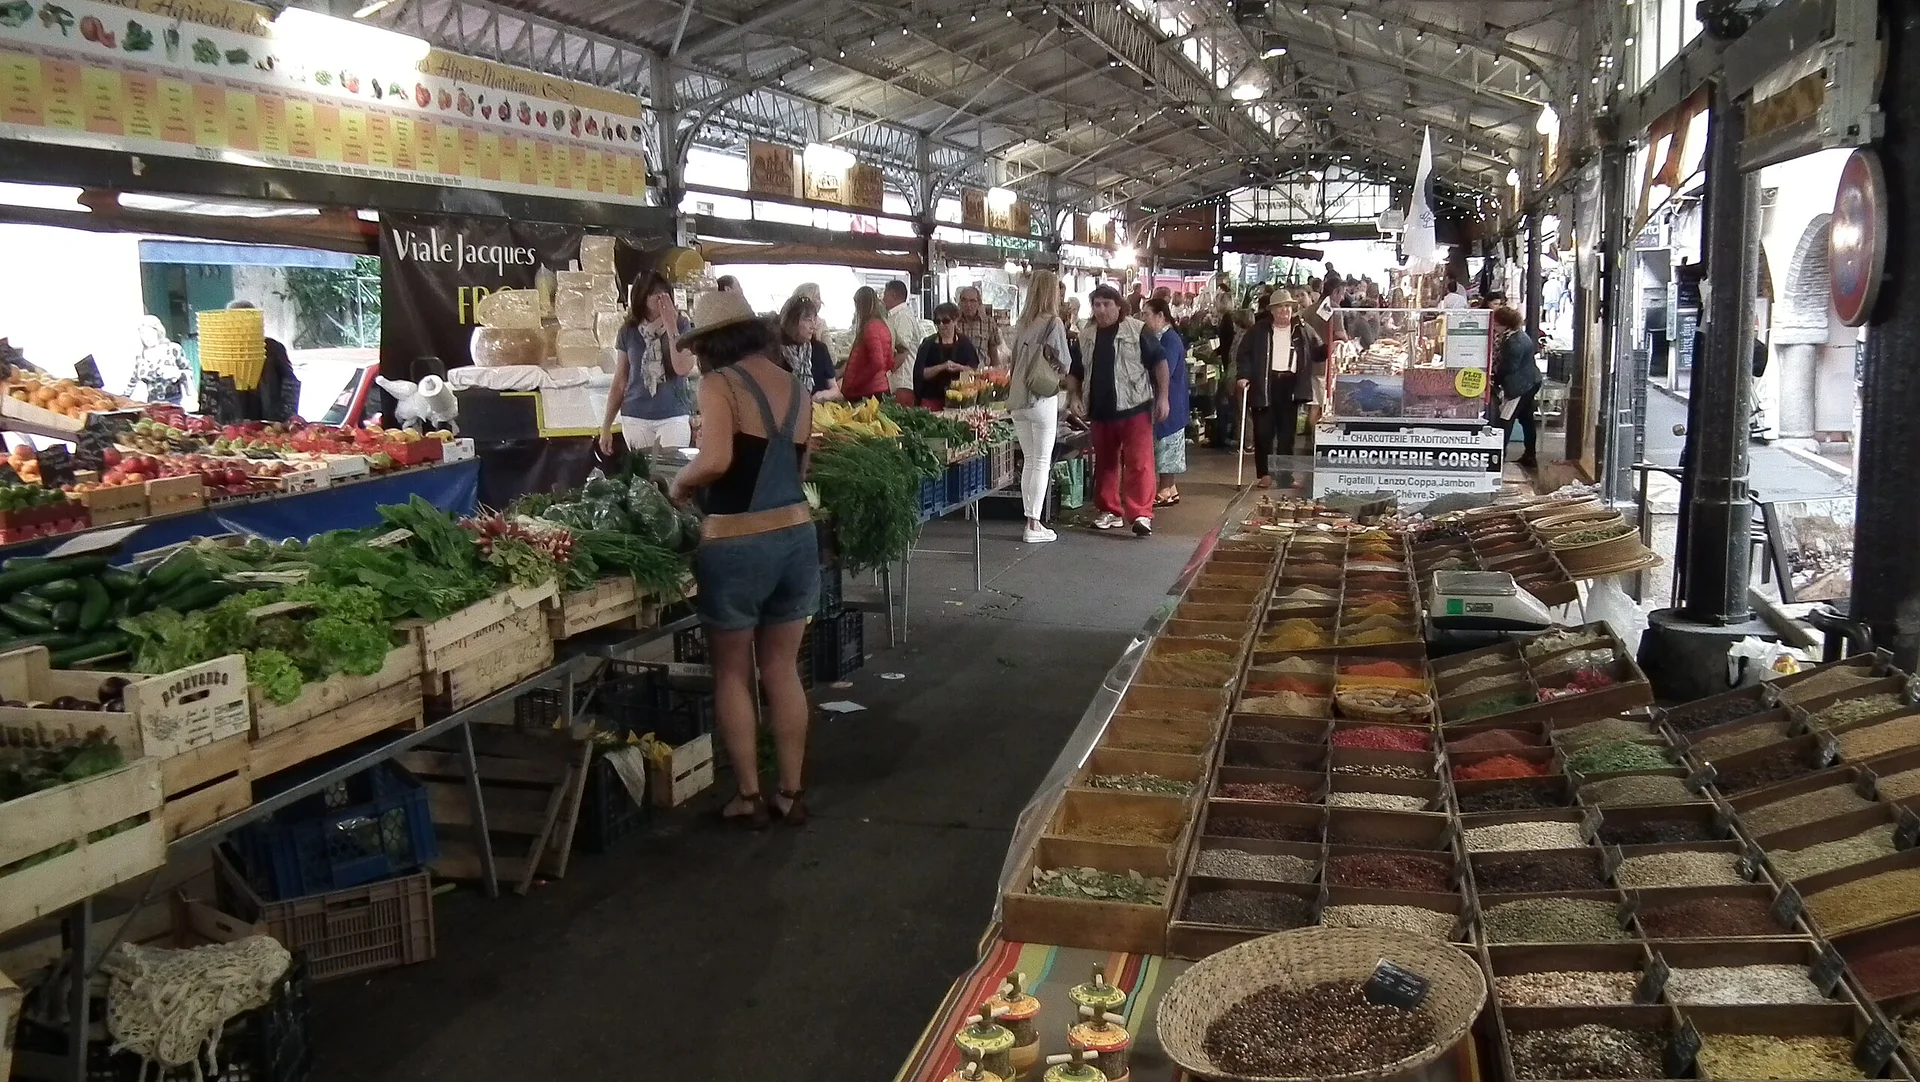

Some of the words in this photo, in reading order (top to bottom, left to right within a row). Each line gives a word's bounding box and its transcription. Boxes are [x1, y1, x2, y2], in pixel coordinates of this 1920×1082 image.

[438, 57, 547, 97] Alpes-Maritimes
[392, 227, 453, 264] Viale
[457, 233, 537, 277] Jacques
[1350, 433, 1408, 444] CHARCUTERIE
[1410, 435, 1480, 445] TRADITIONNELLE
[1327, 448, 1434, 467] CHARCUTERIE
[1438, 451, 1490, 468] CORSE
